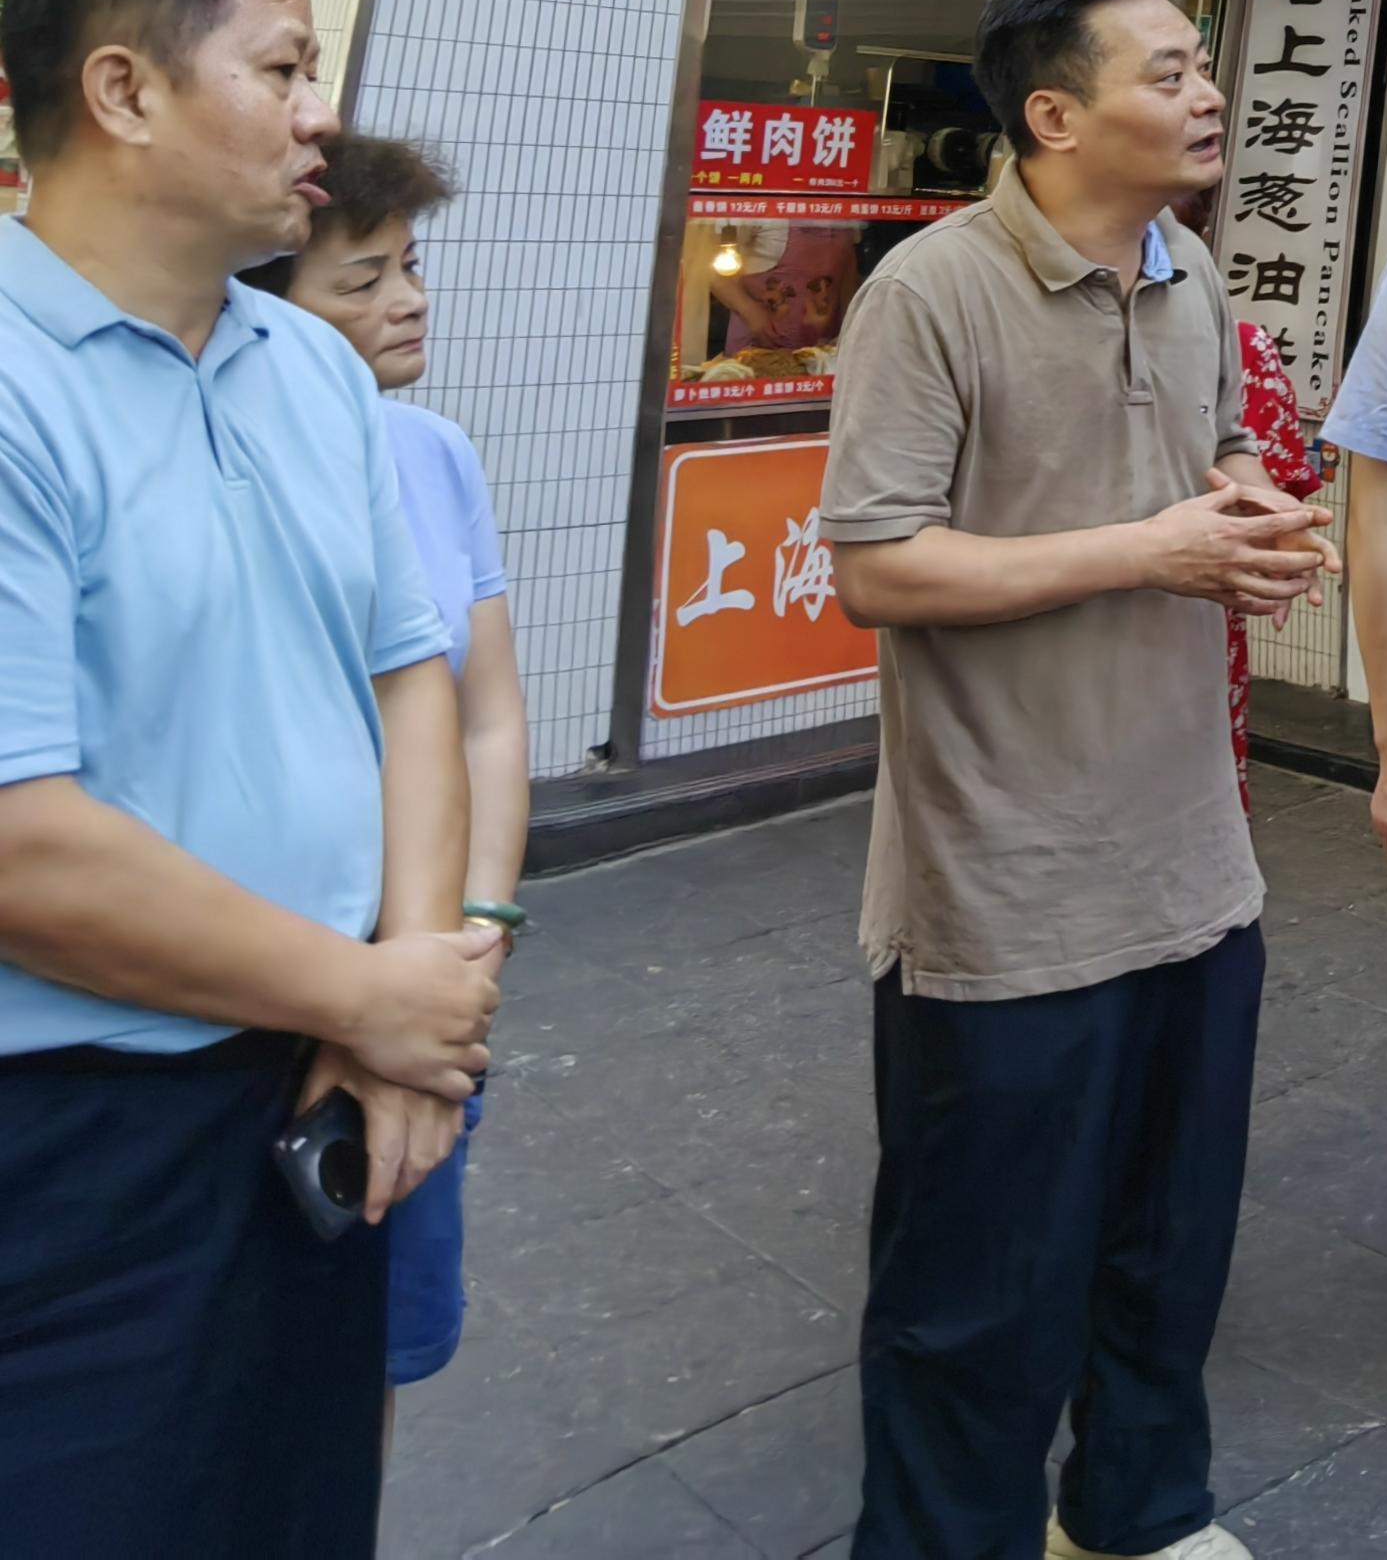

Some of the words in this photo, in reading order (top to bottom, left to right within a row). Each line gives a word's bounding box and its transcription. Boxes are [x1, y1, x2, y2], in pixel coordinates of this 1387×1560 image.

[701, 108, 856, 168] 鲜肉饼
[1325, 81, 1358, 224] Scallion
[1309, 239, 1341, 392] Pancake
[676, 507, 837, 627] 上海
